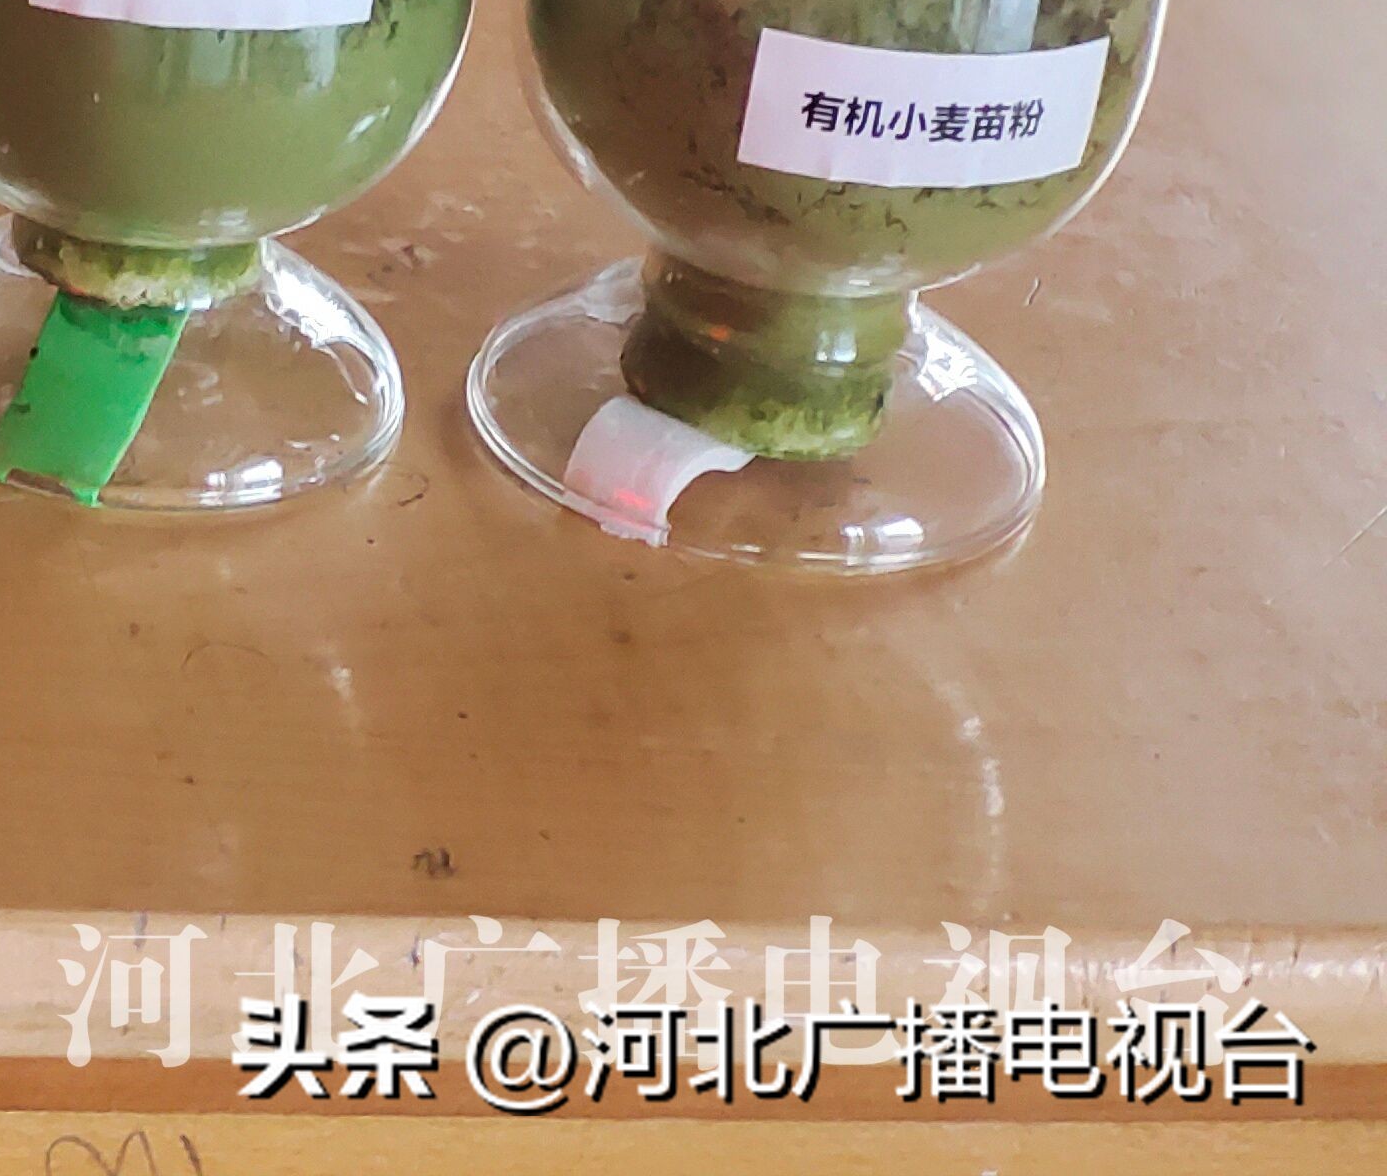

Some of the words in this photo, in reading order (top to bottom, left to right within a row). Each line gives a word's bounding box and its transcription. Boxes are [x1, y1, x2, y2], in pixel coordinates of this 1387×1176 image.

[800, 90, 1046, 143] 有机小麦苗粉
